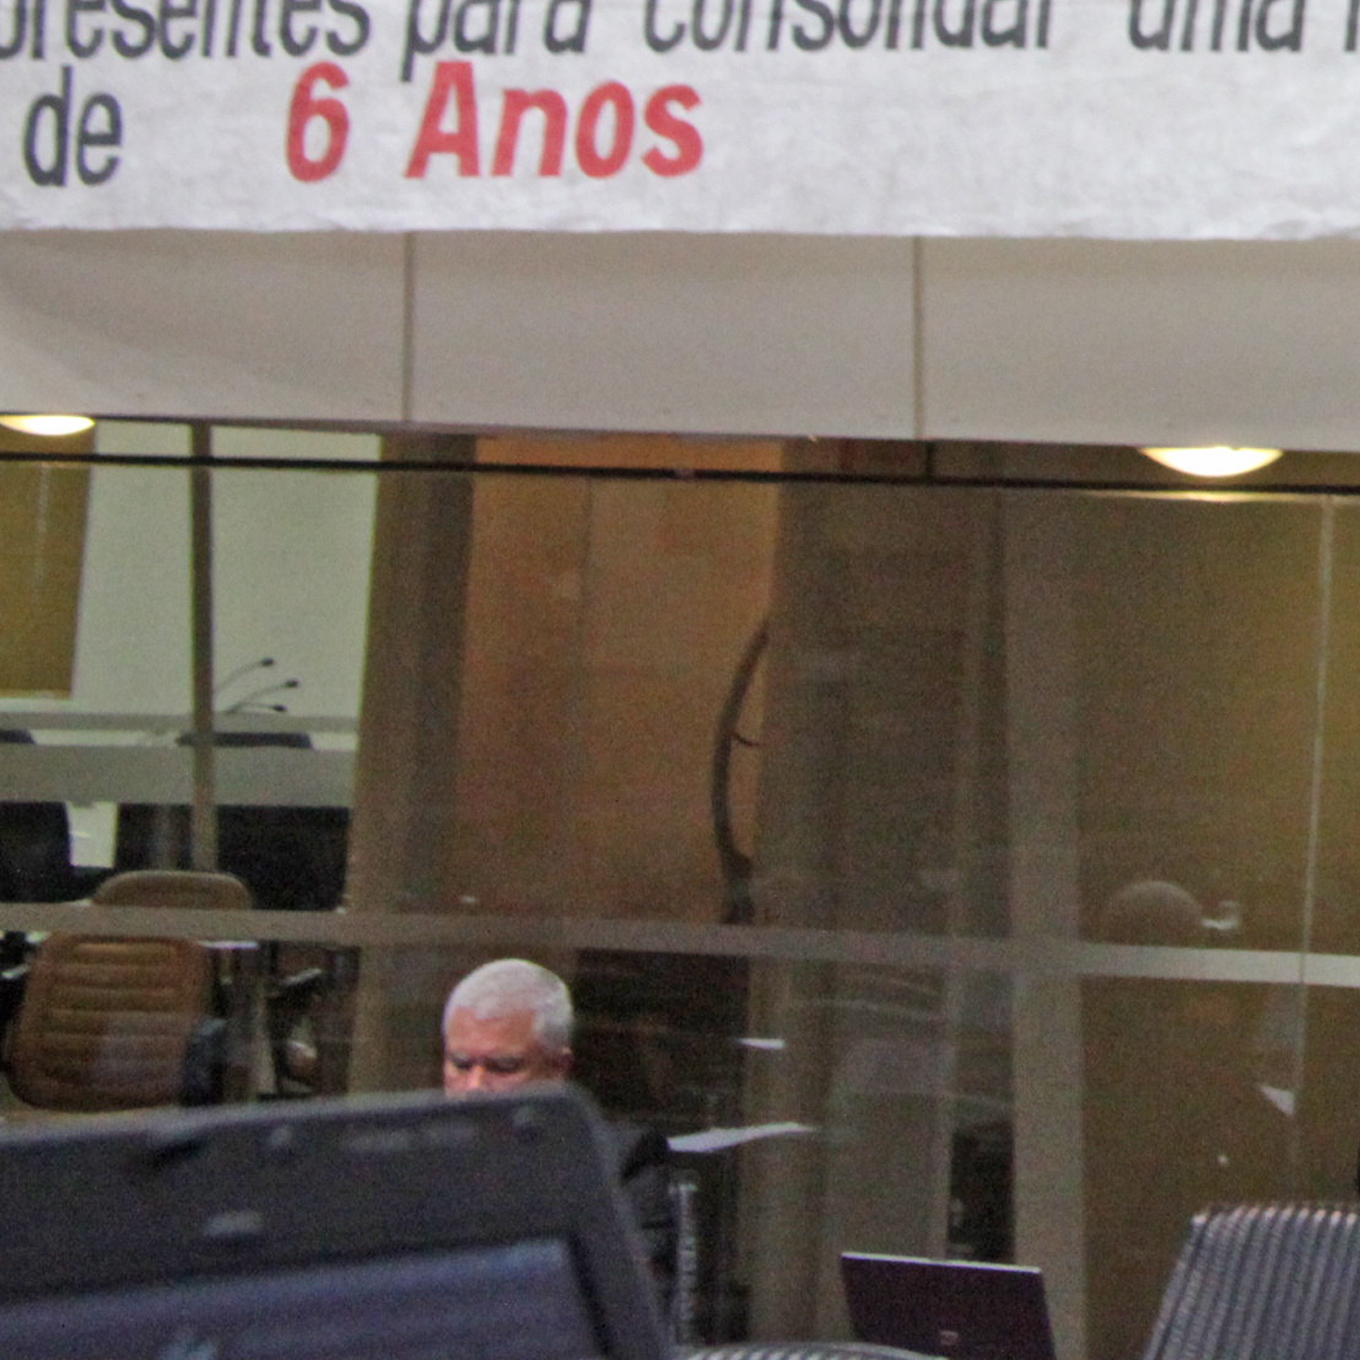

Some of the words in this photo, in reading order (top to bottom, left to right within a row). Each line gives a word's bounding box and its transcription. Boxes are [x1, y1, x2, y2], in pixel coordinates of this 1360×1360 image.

[22, 66, 123, 188] de
[286, 62, 350, 183] 6
[405, 61, 704, 178] Anos
